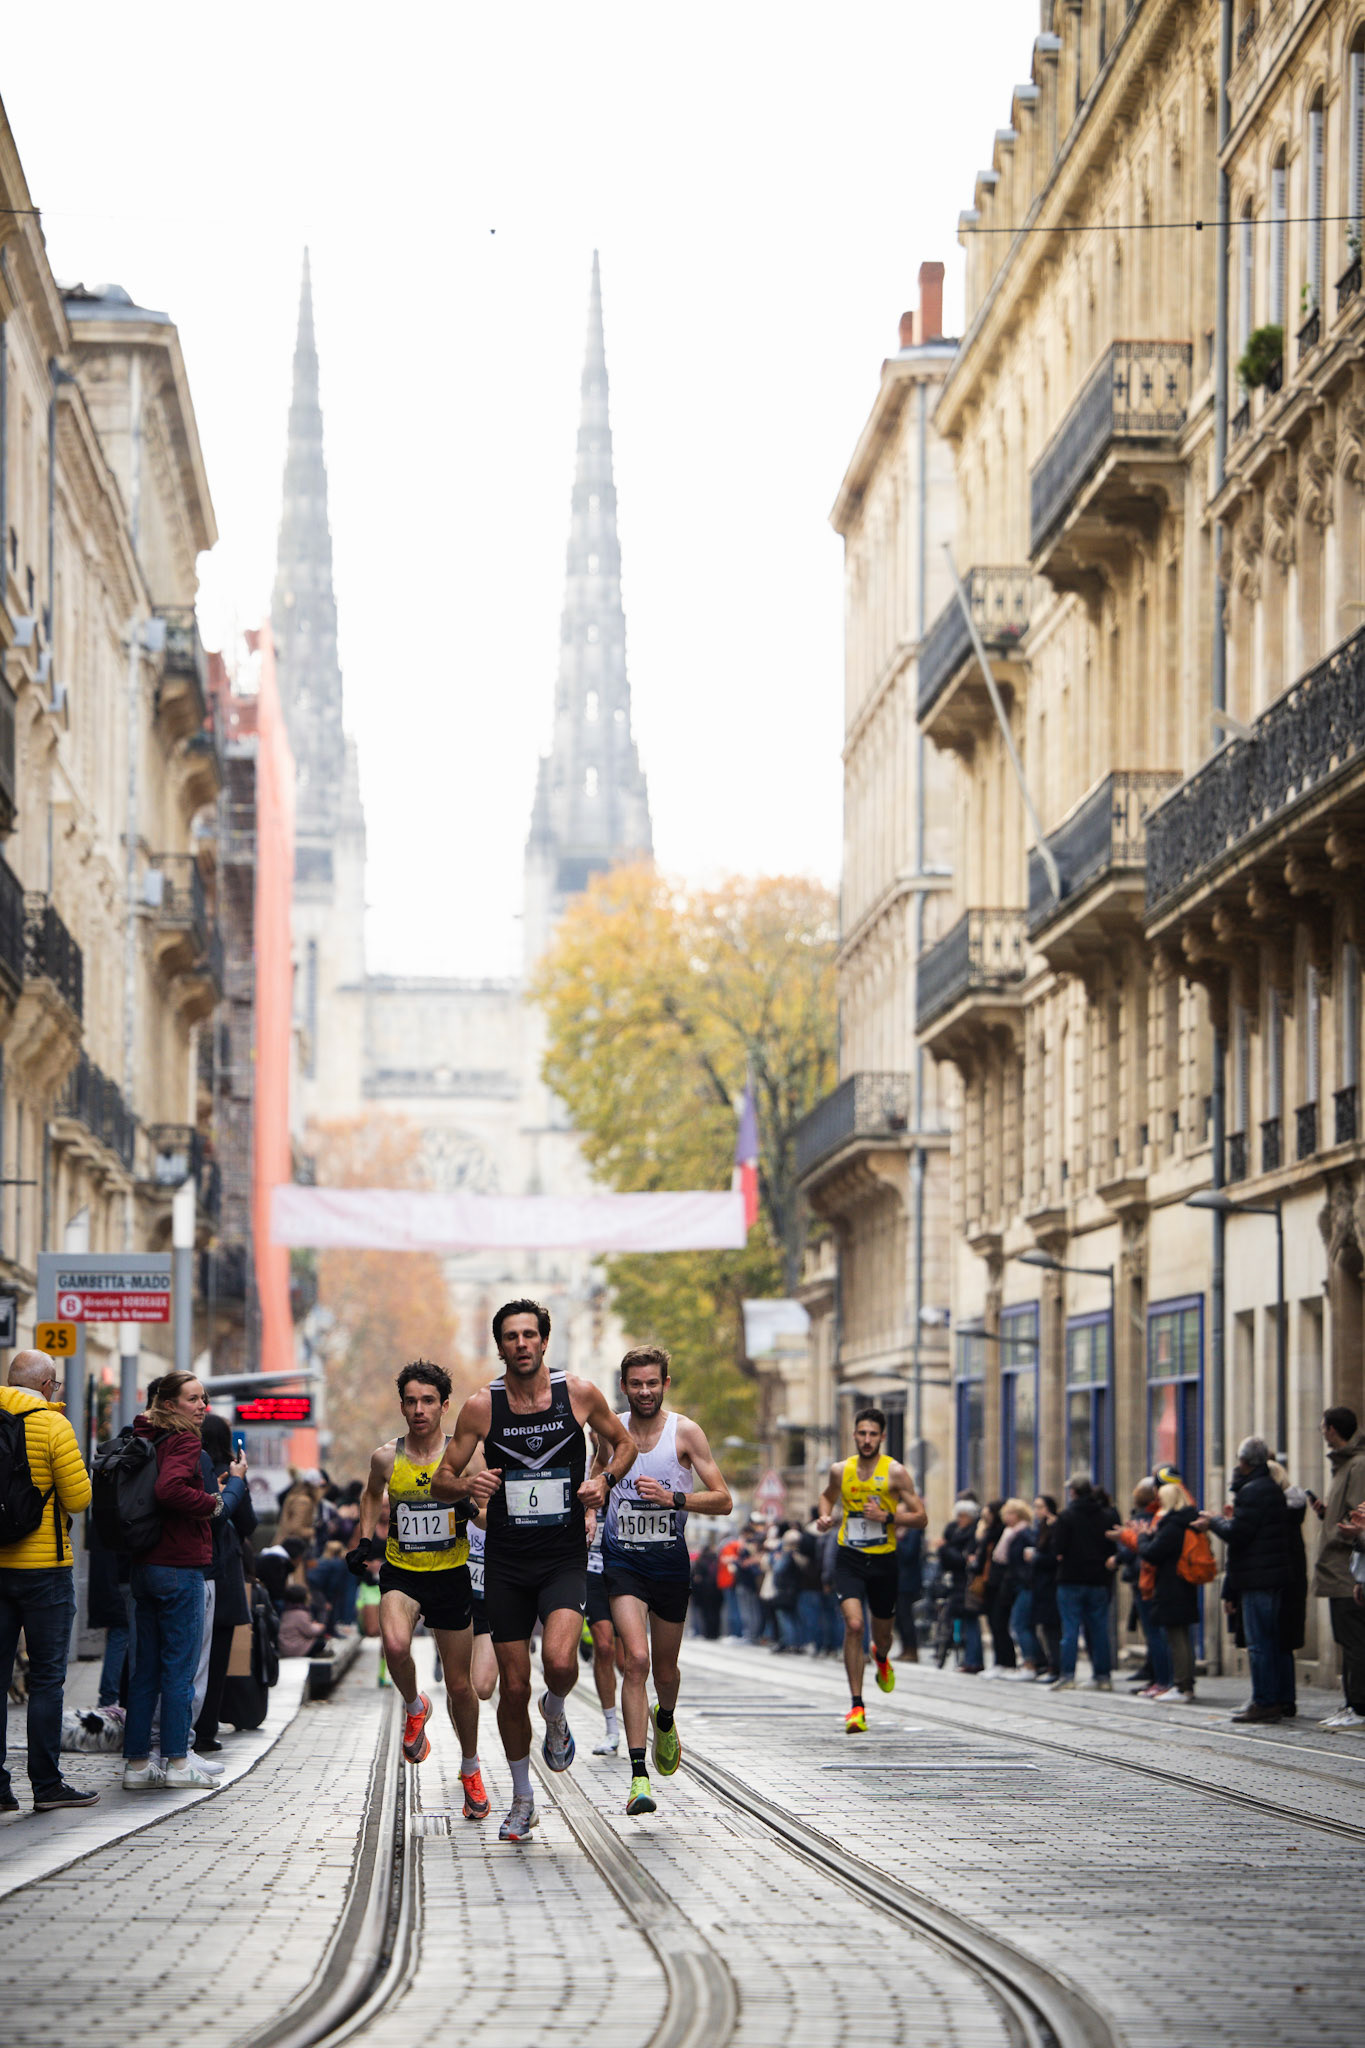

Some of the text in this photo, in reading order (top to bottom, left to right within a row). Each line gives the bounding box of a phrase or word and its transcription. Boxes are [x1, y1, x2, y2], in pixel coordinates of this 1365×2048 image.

[66, 1298, 76, 1312] B
[45, 1329, 69, 1349] 25
[503, 1421, 564, 1437] BORDEAUX
[529, 1486, 538, 1508] 6
[401, 1516, 442, 1535] 2112
[618, 1515, 667, 1535] 15015
